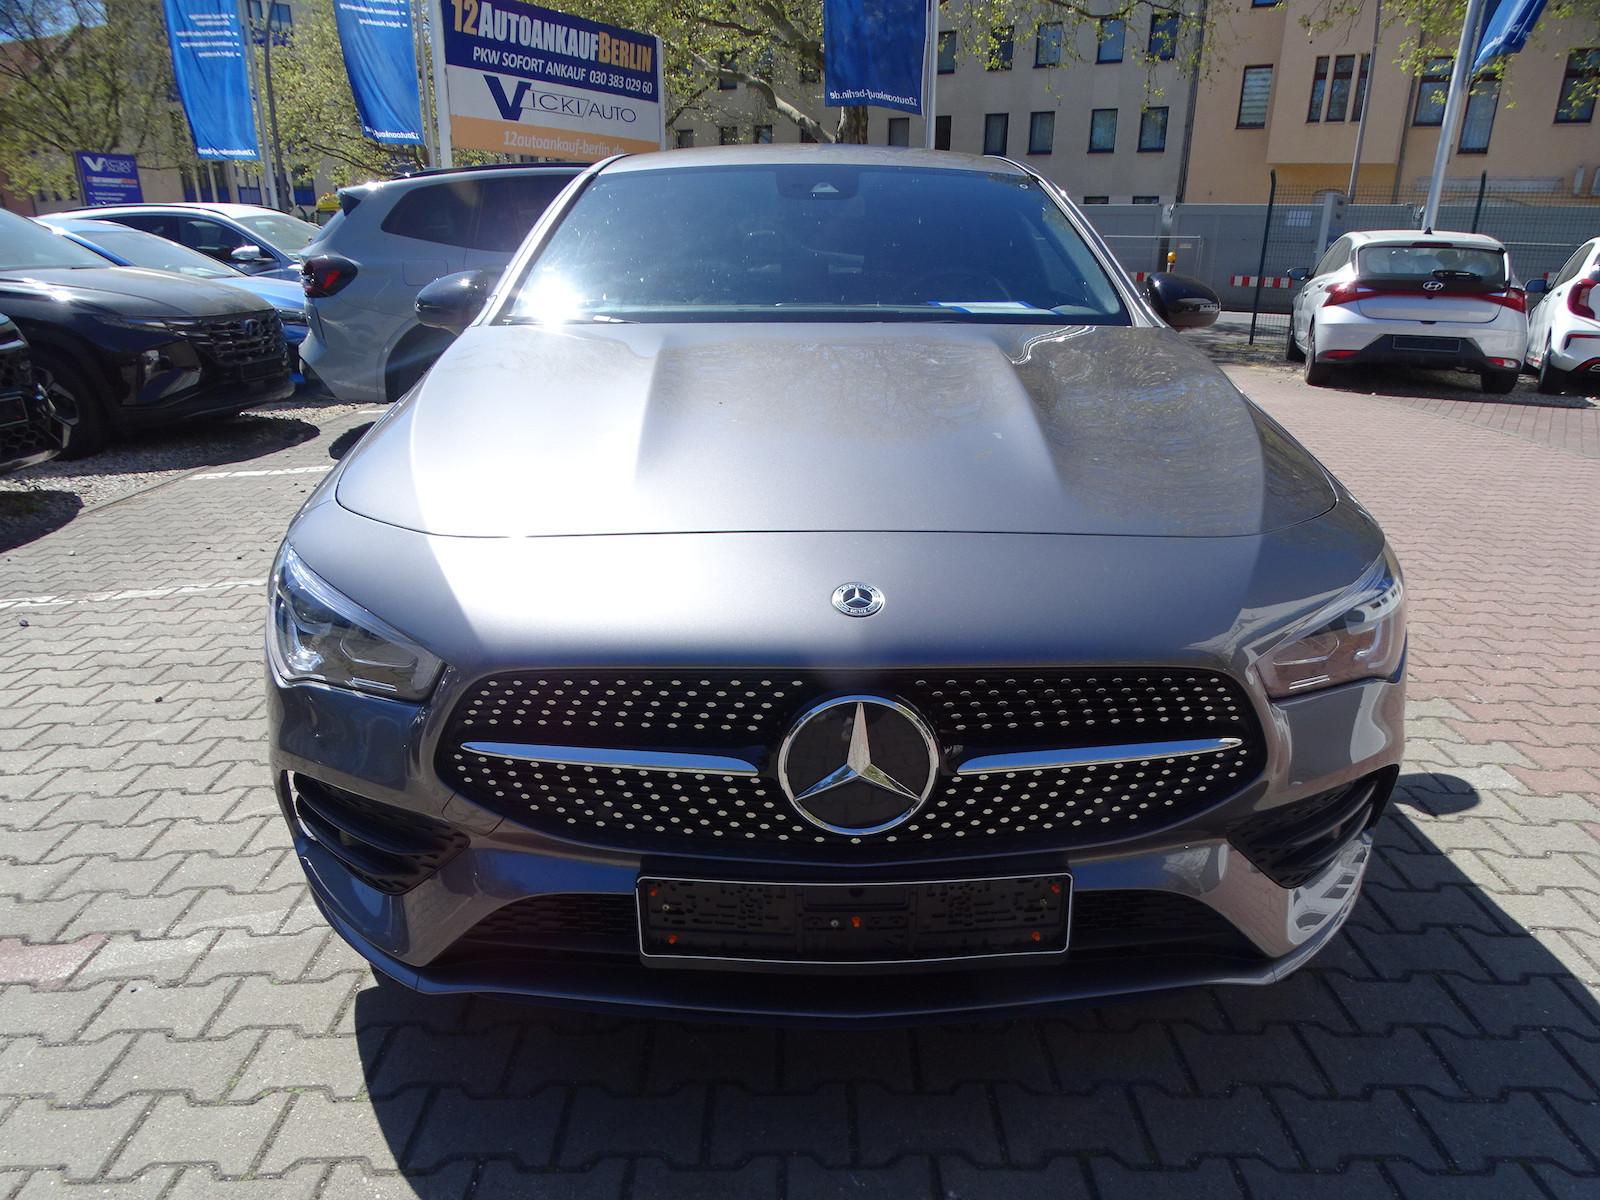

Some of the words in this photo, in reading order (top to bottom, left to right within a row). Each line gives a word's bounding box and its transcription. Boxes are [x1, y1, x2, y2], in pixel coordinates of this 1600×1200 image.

[472, 46, 501, 66] PKW
[501, 52, 545, 74] SOFORT
[545, 60, 587, 82] ANKAUF
[589, 70, 607, 85] 030
[608, 74, 625, 89] 383
[625, 78, 642, 93] 029
[642, 81, 653, 95] 60
[483, 74, 583, 122] VICKI
[588, 103, 637, 124] AUTO
